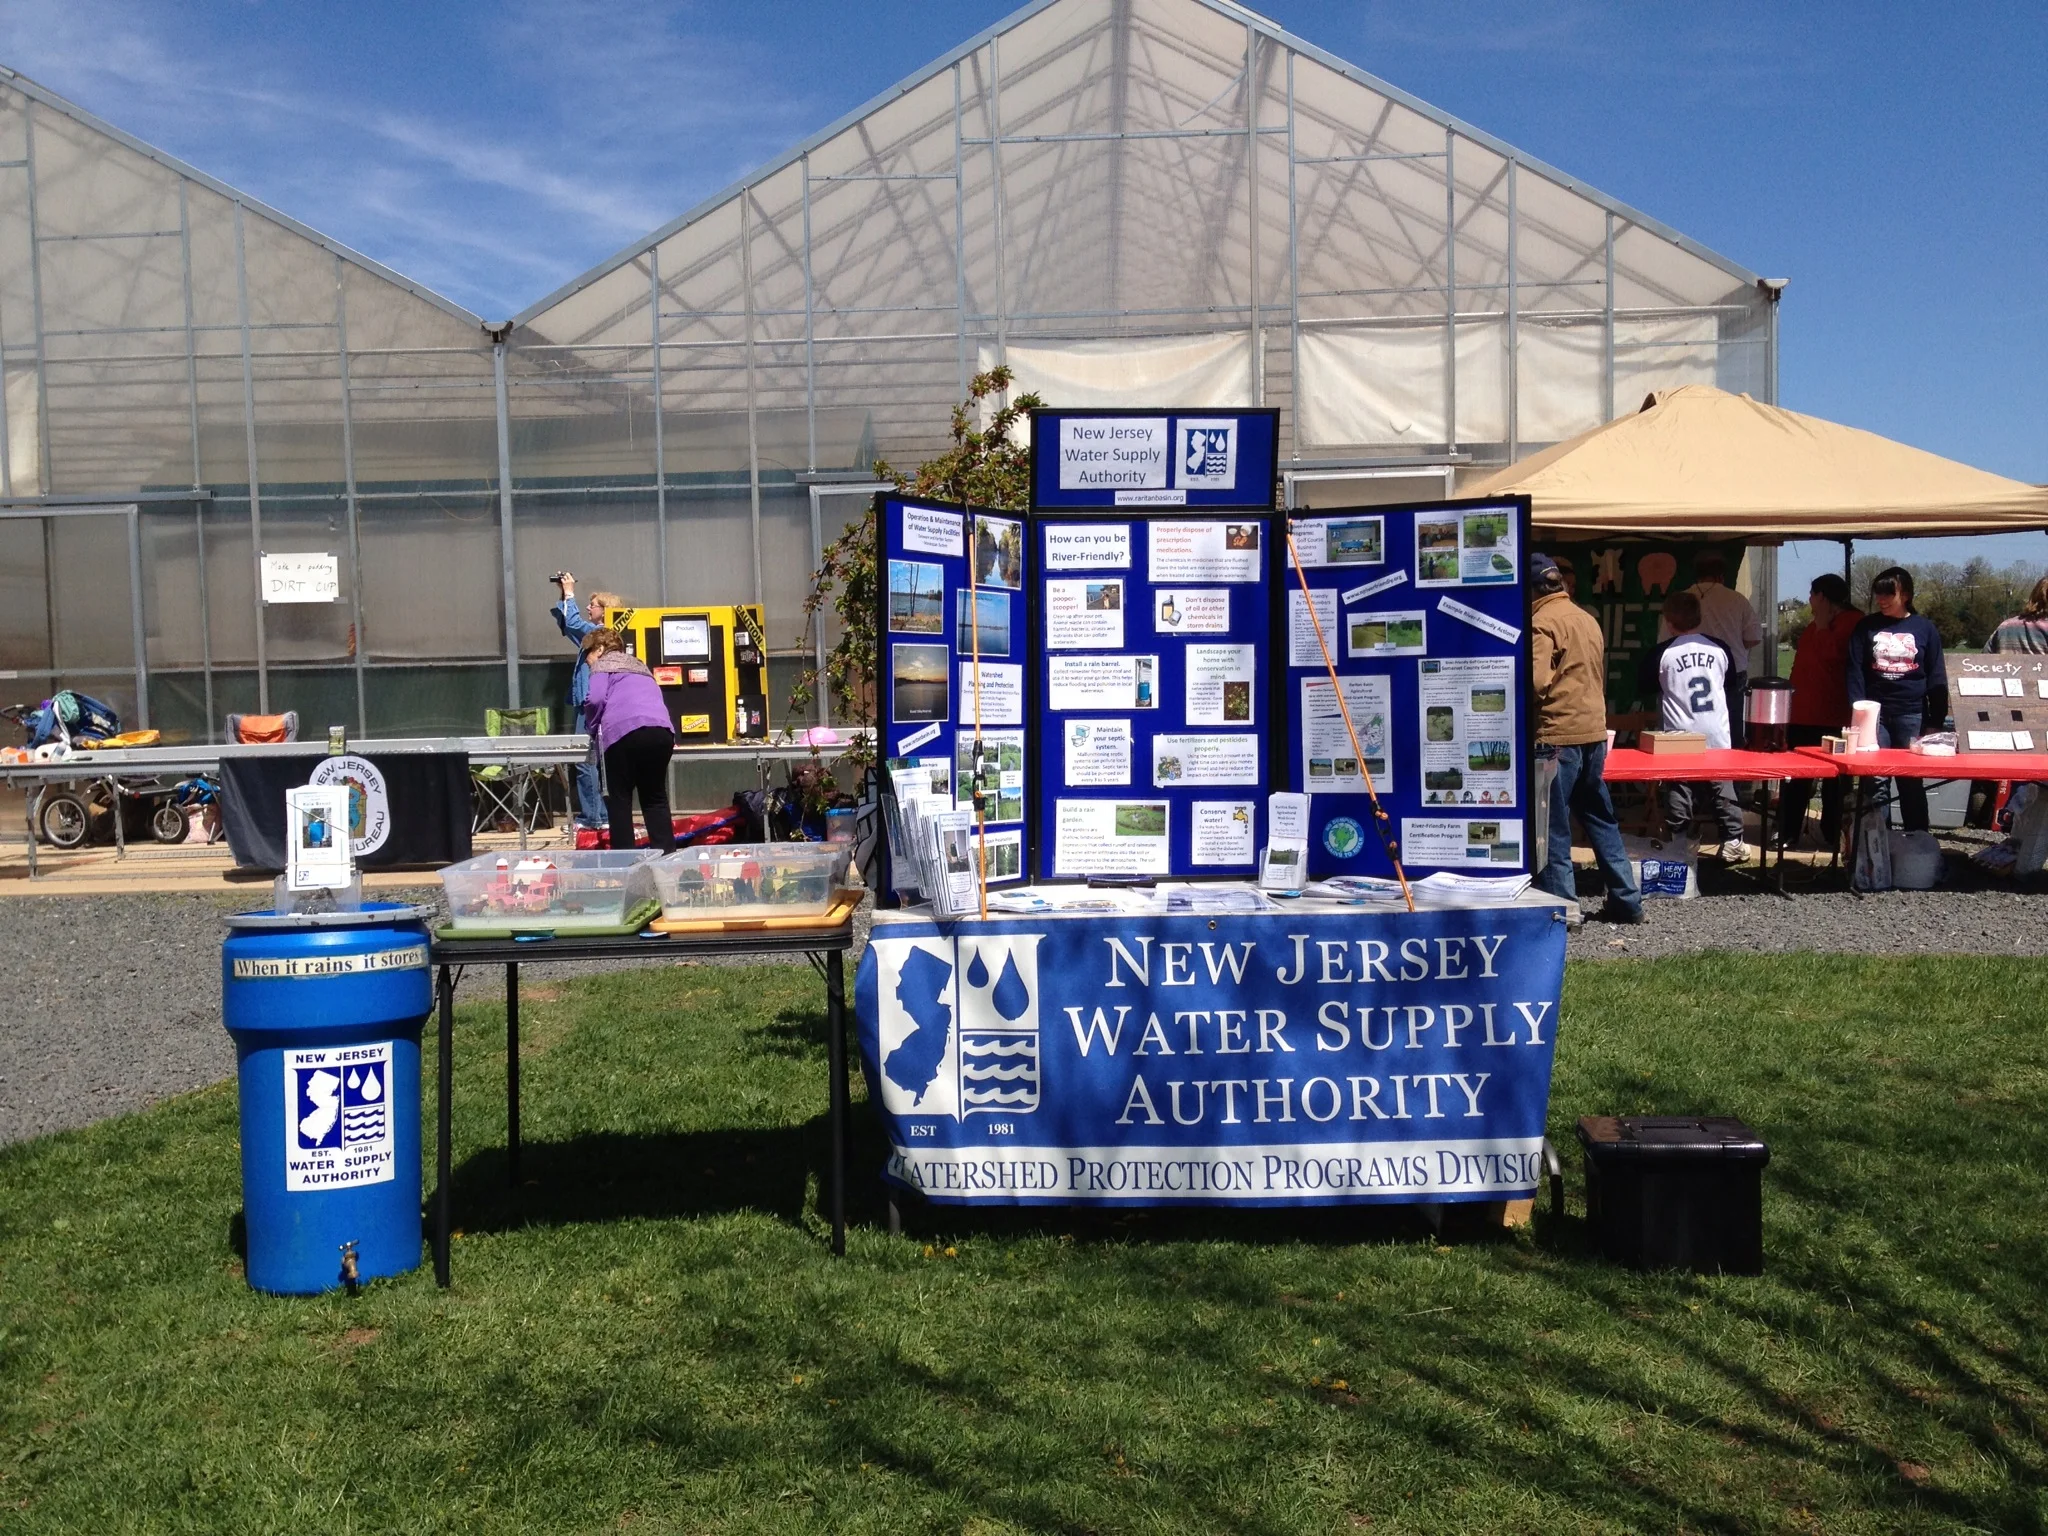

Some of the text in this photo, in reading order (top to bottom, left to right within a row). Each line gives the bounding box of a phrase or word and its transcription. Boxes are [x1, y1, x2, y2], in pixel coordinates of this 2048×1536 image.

[1073, 427, 1152, 441] New Jersey
[1065, 449, 1160, 463] Water Supply
[1079, 470, 1146, 485] Authority
[1117, 494, 1184, 502] www.raritanbasin.org
[907, 512, 928, 522] Operation
[935, 517, 961, 526] Maintenance
[928, 526, 942, 535] Supply
[943, 527, 960, 536] Facilities
[1050, 535, 1071, 543] How
[1093, 536, 1111, 544] you
[1114, 534, 1126, 542] be
[1052, 552, 1124, 562] River-Friendly?
[271, 580, 336, 592] DIRT CUP
[736, 605, 763, 644] CAUTION
[1442, 601, 1516, 639] Example River-Friendly Actions
[1676, 652, 1715, 673] JETER
[1962, 659, 2042, 675] Society of
[1688, 676, 1714, 713] 2
[317, 761, 381, 794] EW JERSEY
[356, 811, 384, 851] UREAU
[238, 949, 419, 976] When it rains it stores
[1103, 934, 1508, 987] NEW JERSEY
[1063, 1000, 1553, 1057] WATER SUPPLY
[295, 1048, 384, 1064] NEW JERSEY
[1114, 1072, 1492, 1126] AUTHORITY
[910, 1124, 1015, 1137] EST 1981
[354, 1145, 373, 1154] 1981
[290, 1151, 391, 1171] WATER SUPPLY
[303, 1167, 380, 1184] AUTHORITY
[1066, 1156, 1254, 1190] PROTECTION
[1262, 1154, 1428, 1190] PROGRAMS
